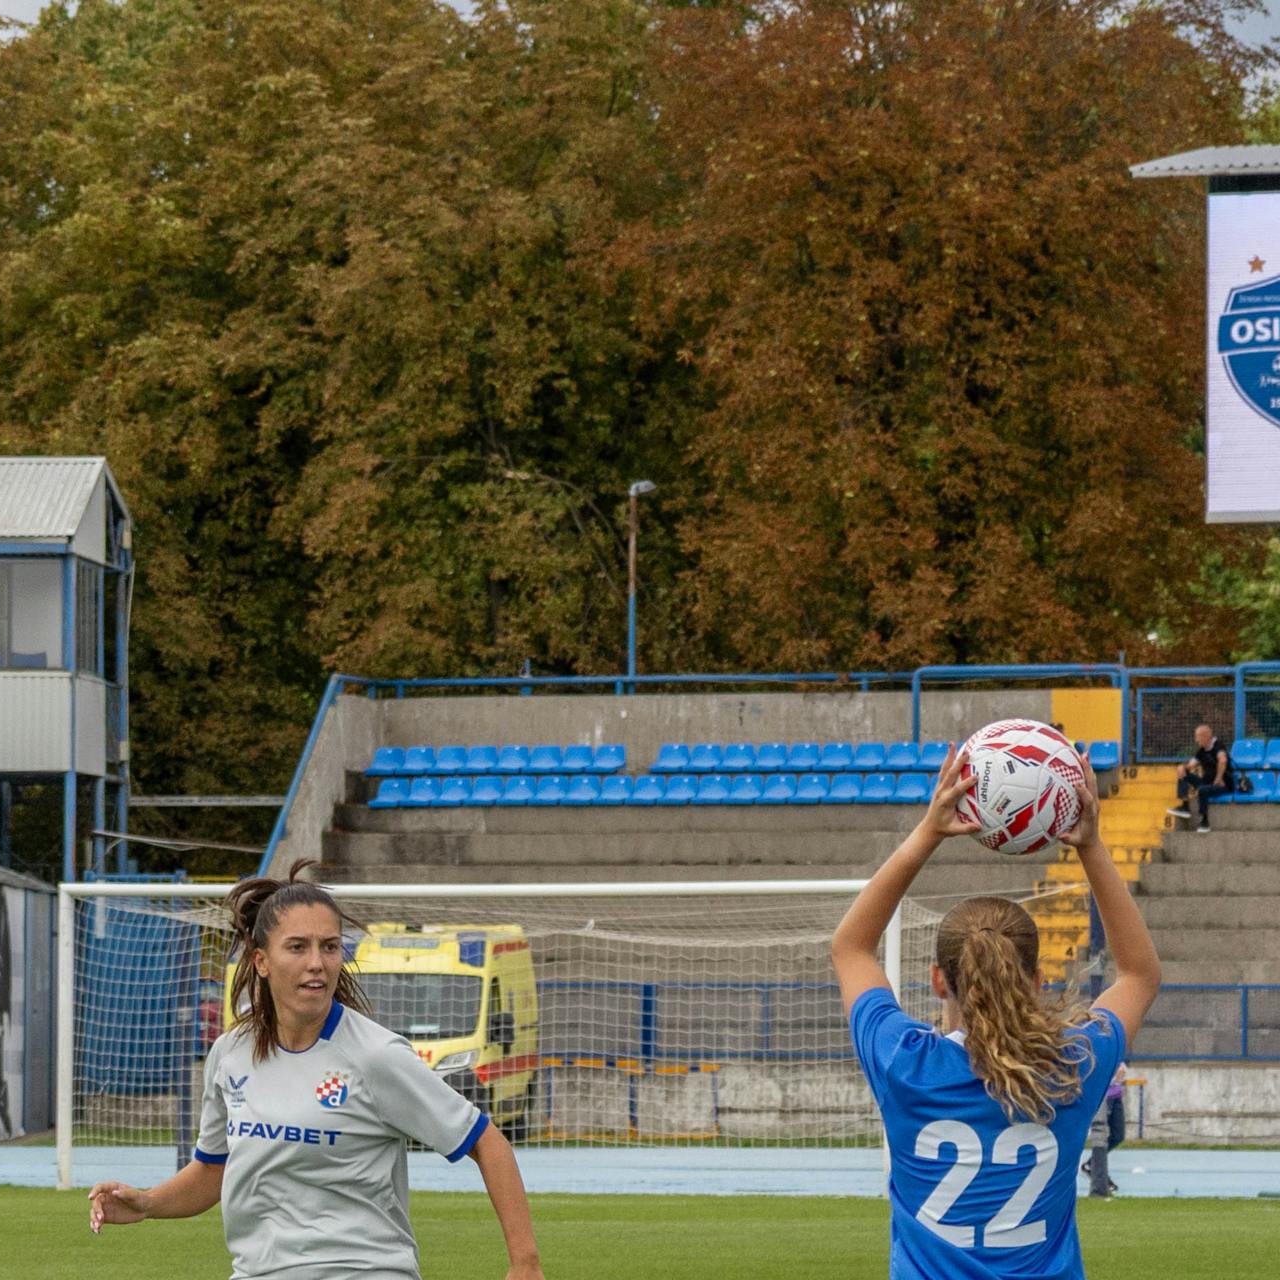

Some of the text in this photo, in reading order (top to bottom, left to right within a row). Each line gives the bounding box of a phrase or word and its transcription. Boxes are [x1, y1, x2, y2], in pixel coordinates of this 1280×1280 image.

[981, 761, 992, 802] uhlsport
[1122, 768, 1137, 779] 10
[238, 1121, 342, 1146] FAVBET
[914, 1119, 1059, 1248] 22
